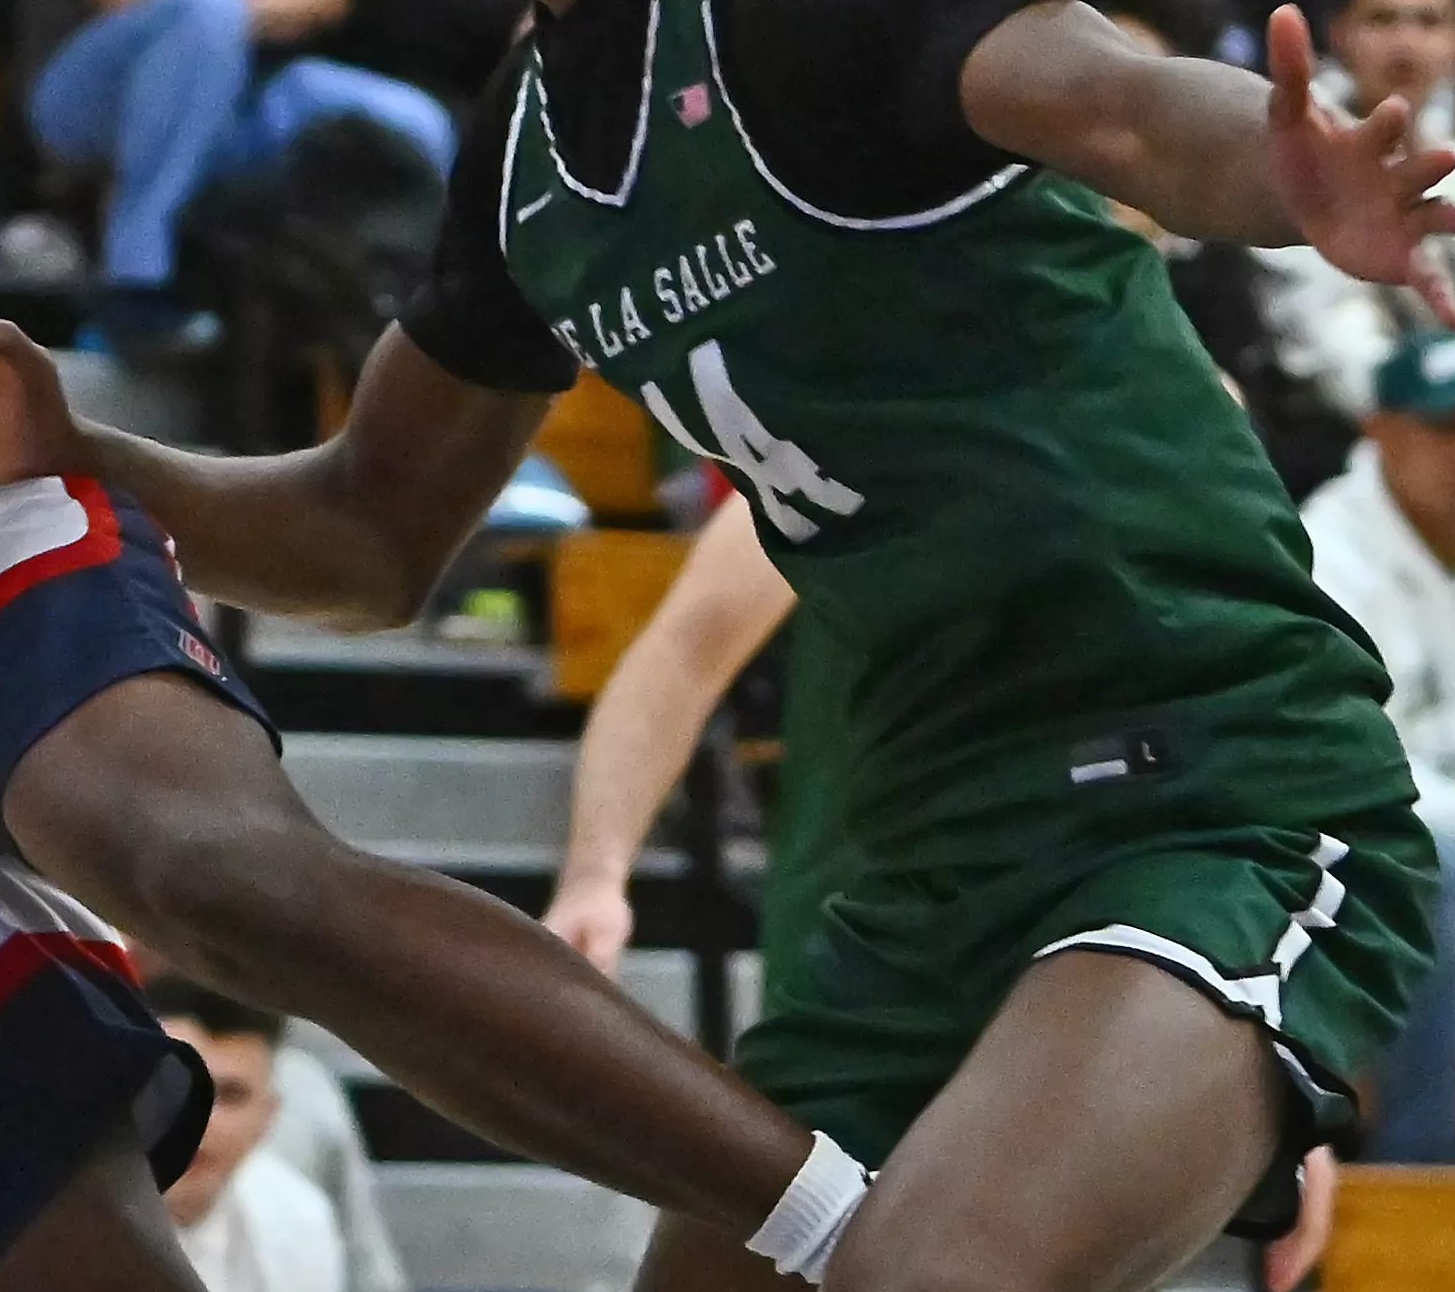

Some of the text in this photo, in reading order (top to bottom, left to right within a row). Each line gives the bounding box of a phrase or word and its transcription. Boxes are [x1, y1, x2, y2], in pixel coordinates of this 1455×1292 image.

[550, 217, 778, 369] E LA SALLE
[640, 337, 868, 545] 14
